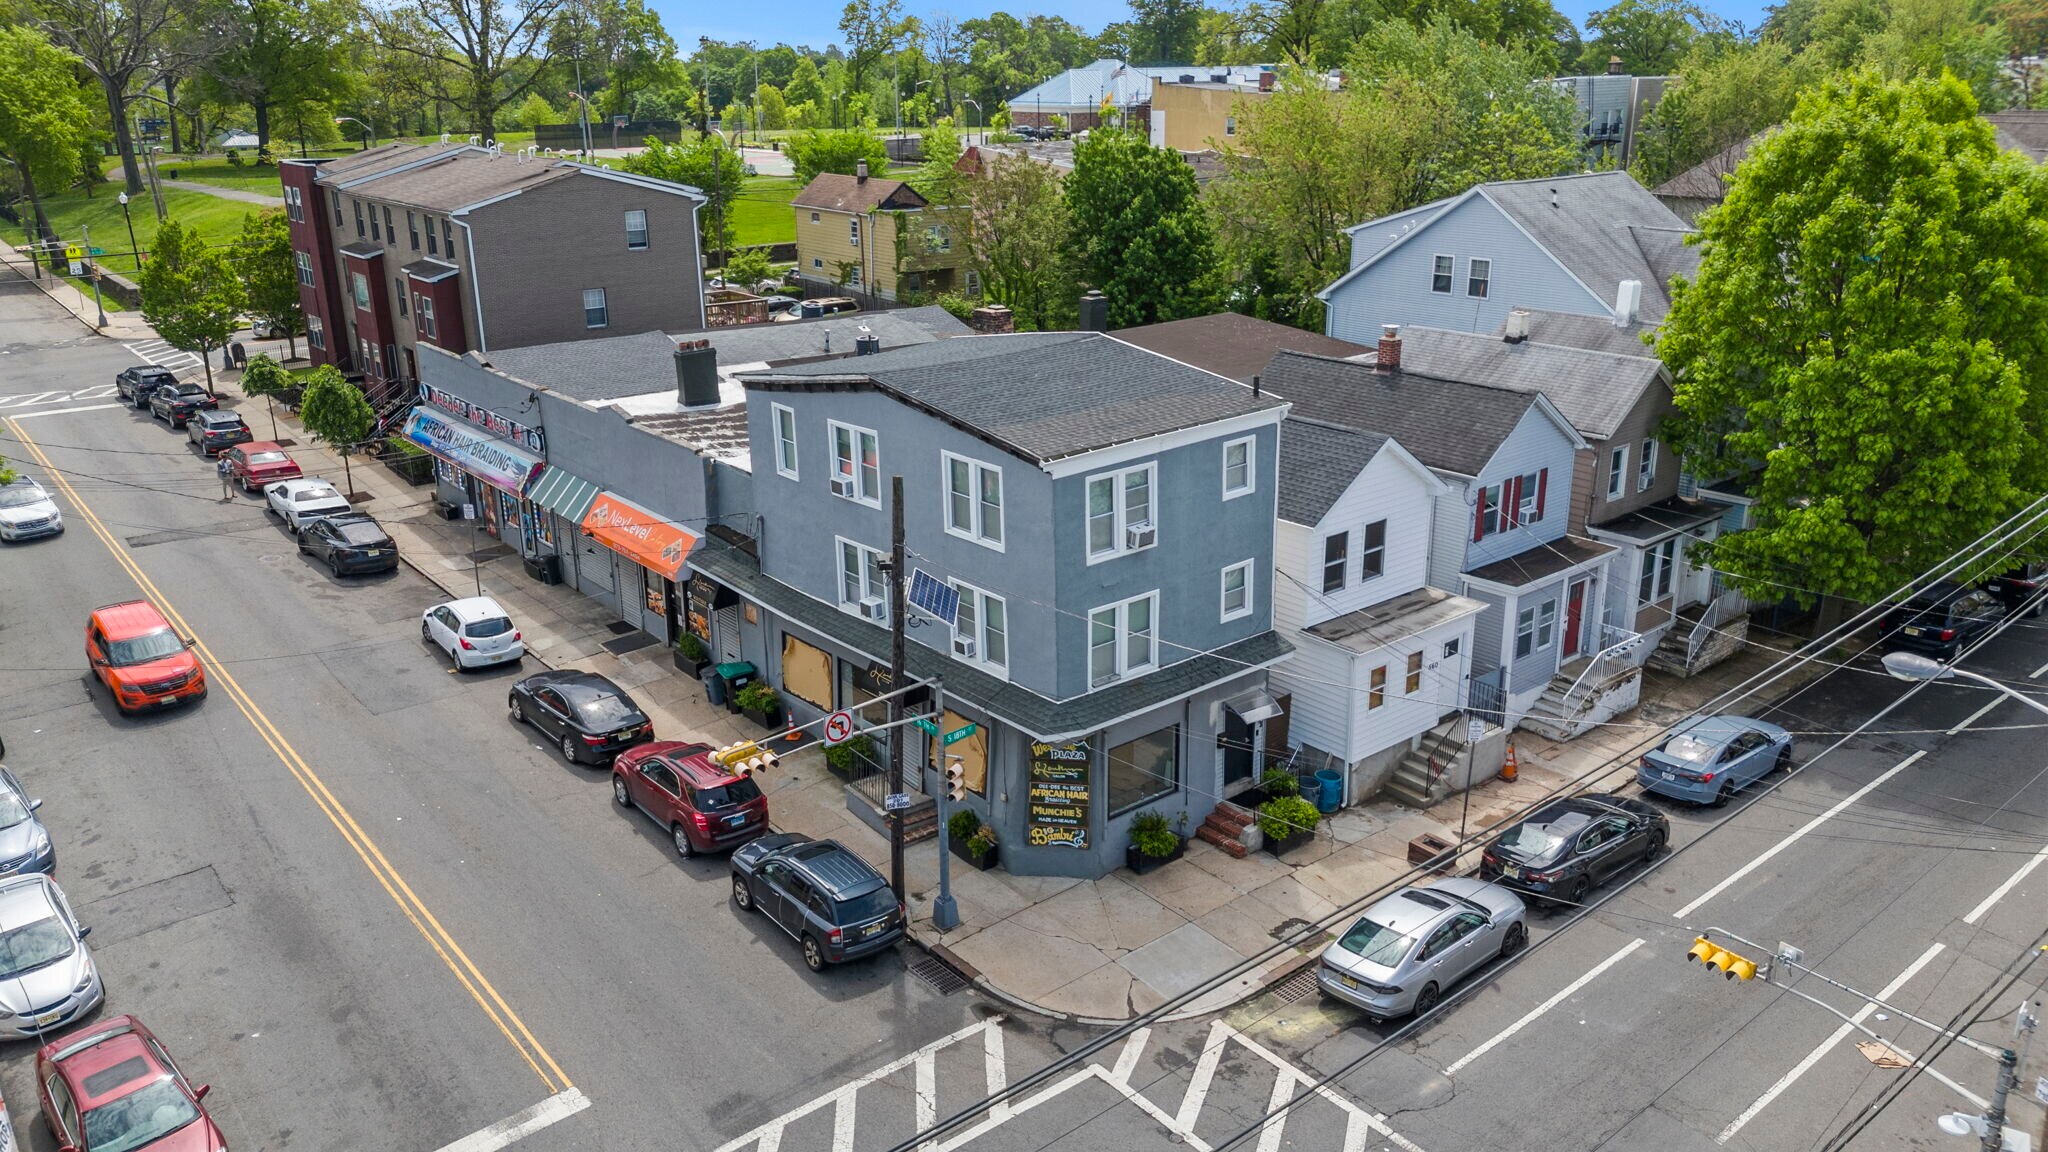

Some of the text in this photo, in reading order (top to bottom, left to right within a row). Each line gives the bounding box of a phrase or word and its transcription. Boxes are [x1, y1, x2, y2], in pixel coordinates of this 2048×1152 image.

[486, 411, 512, 440] Best
[423, 420, 453, 445] AFRICAN
[453, 430, 473, 454] HAIR
[471, 441, 511, 472] BRAIDING
[608, 509, 652, 540] NexLevel
[947, 735, 952, 743] S
[953, 729, 966, 741] 18TH
[1050, 749, 1086, 760] PLAZA
[1031, 788, 1089, 800] AFRICAN HAIR
[1032, 805, 1083, 818] MUNCHIE'S
